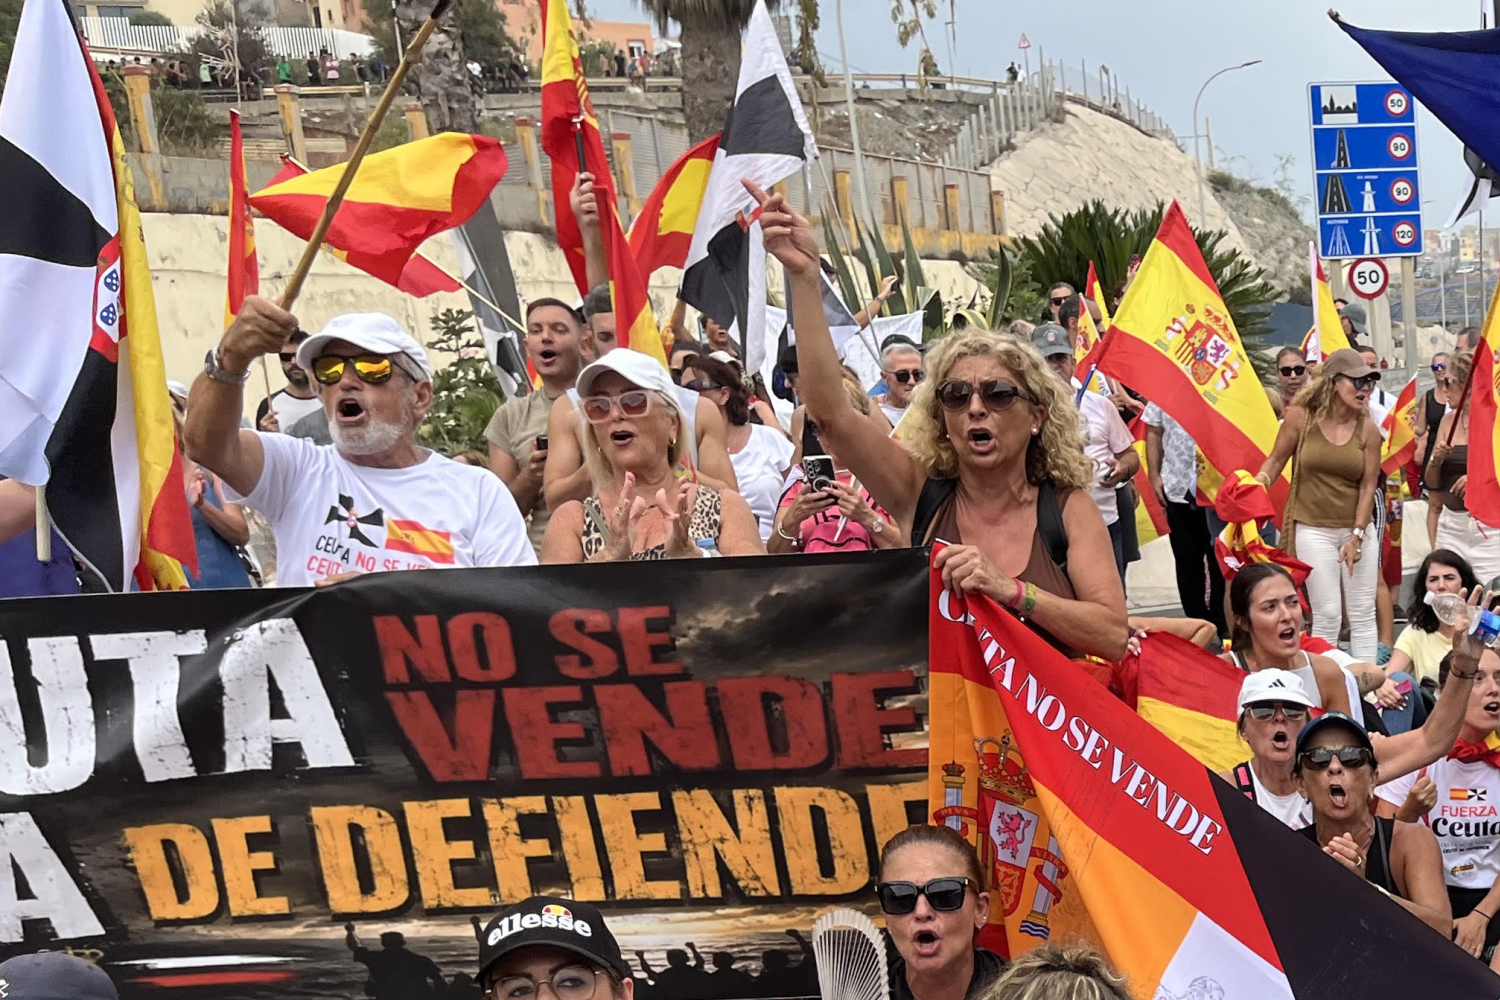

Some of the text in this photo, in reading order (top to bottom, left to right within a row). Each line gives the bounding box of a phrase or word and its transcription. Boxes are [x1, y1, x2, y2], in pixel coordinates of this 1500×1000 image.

[1390, 99, 1403, 108] 50
[1393, 142, 1406, 152] 90
[1395, 187, 1409, 196] 90
[1396, 230, 1413, 239] 120
[1357, 270, 1380, 285] 50
[315, 535, 350, 564] CEUA
[355, 551, 377, 572] NO
[306, 555, 342, 577] CEUT
[373, 611, 518, 685] NO
[550, 605, 683, 680] SE
[382, 668, 929, 782] VENDE
[938, 589, 1223, 855] CTA NO SE VENDE
[1441, 805, 1498, 817] FUERZA
[122, 815, 291, 920] DE
[487, 912, 593, 947] ellesse
